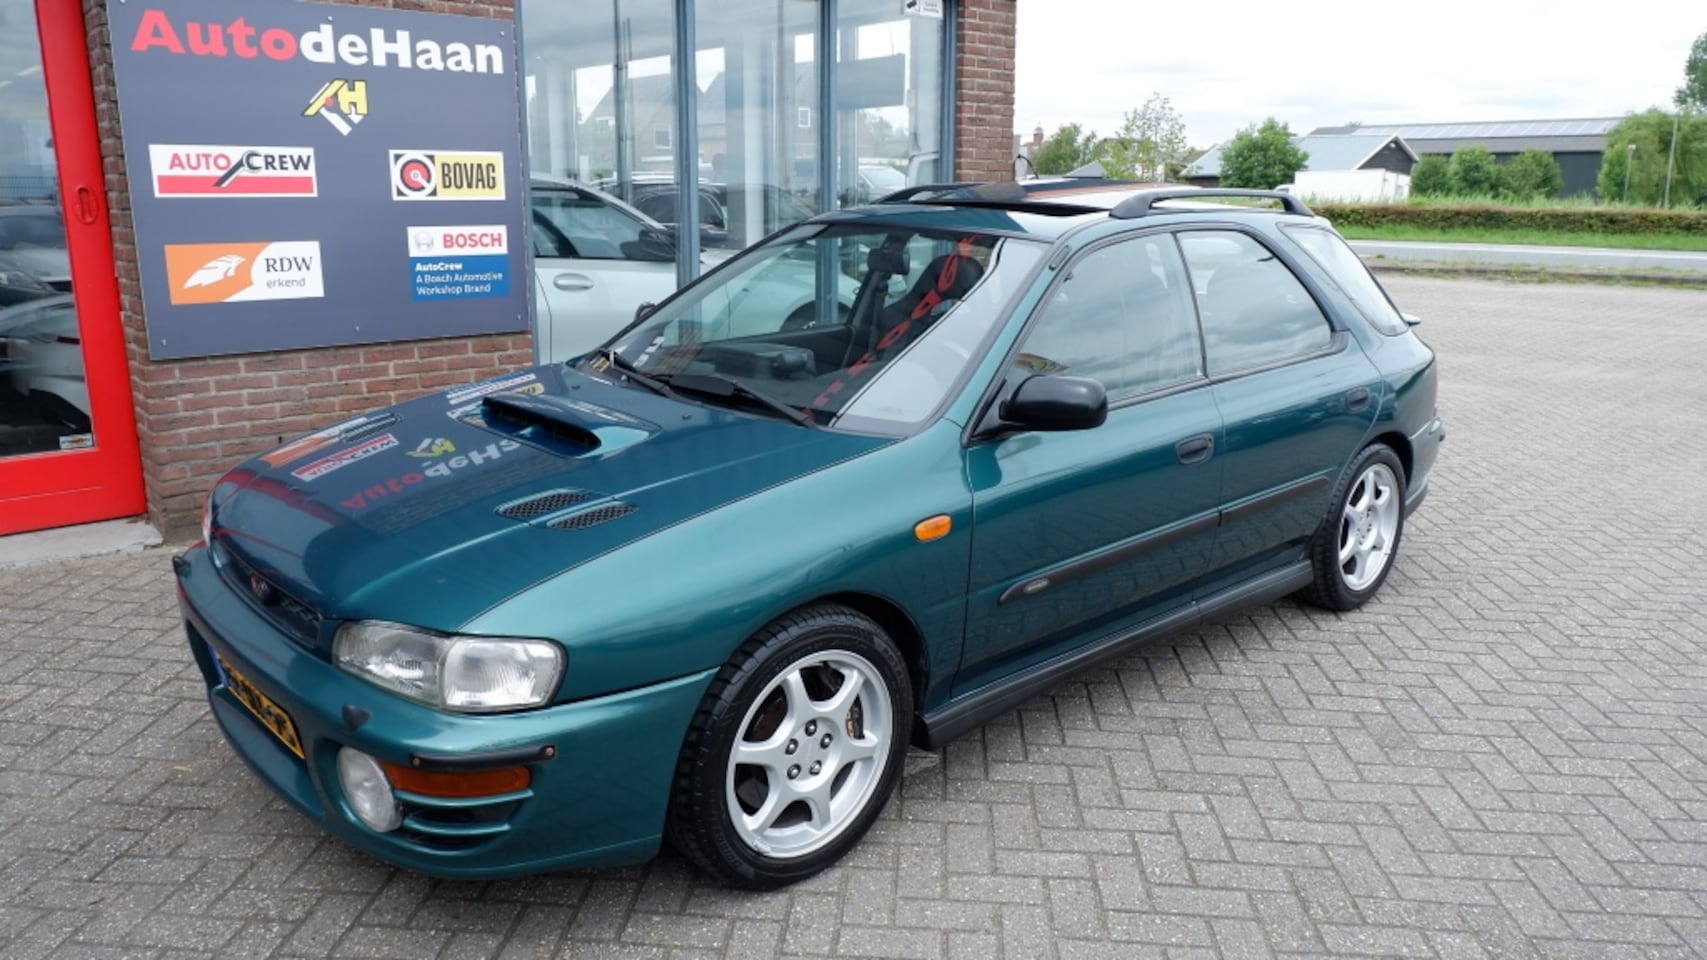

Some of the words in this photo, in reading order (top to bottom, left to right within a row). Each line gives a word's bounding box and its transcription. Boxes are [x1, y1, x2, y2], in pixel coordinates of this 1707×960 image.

[131, 9, 504, 74] AutodeHaan
[169, 152, 232, 171] AUTO
[245, 152, 311, 171] CREW
[441, 162, 496, 189] BOVAG
[443, 232, 502, 249] BOSCH
[264, 255, 313, 273] RDW
[415, 262, 463, 272] AutoCrew
[266, 277, 306, 288] erkend
[416, 275, 423, 283] A
[424, 274, 453, 283] Bosch
[454, 272, 503, 282] Automotive
[416, 286, 463, 296] Workshop
[464, 284, 491, 293] Brand
